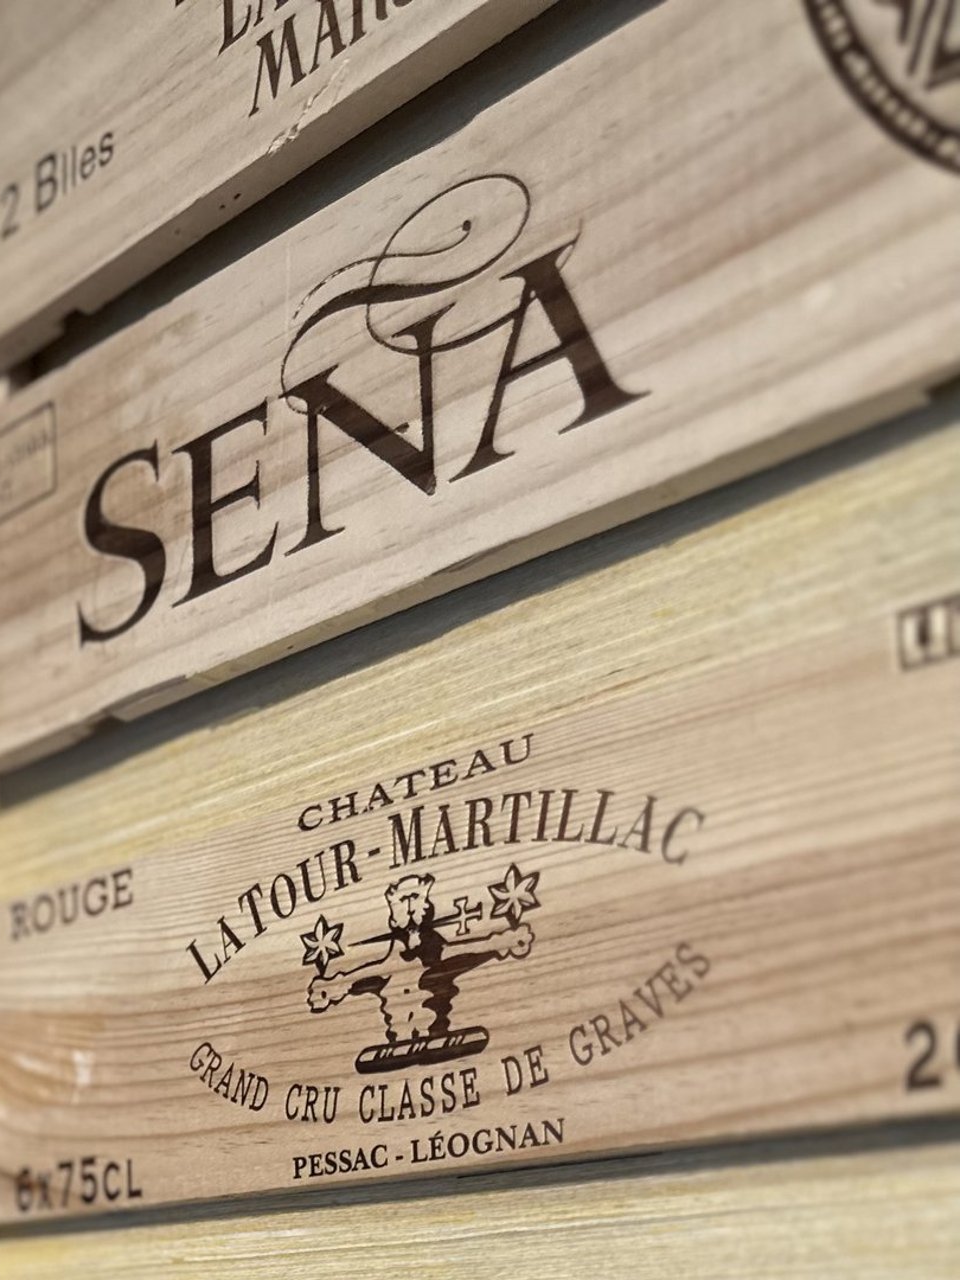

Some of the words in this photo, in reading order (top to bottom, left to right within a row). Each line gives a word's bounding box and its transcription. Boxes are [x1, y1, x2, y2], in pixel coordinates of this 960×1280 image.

[248, 0, 418, 118] MAR
[297, 732, 535, 831] CHATEAU
[9, 867, 135, 943] ROUGE
[189, 1041, 270, 1113] GRAND
[285, 1083, 340, 1124] CRU
[359, 1066, 482, 1124] CLASSE
[502, 1045, 550, 1097] DE
[568, 940, 712, 1067] GRAVES
[15, 1156, 143, 1213] 6x75CL
